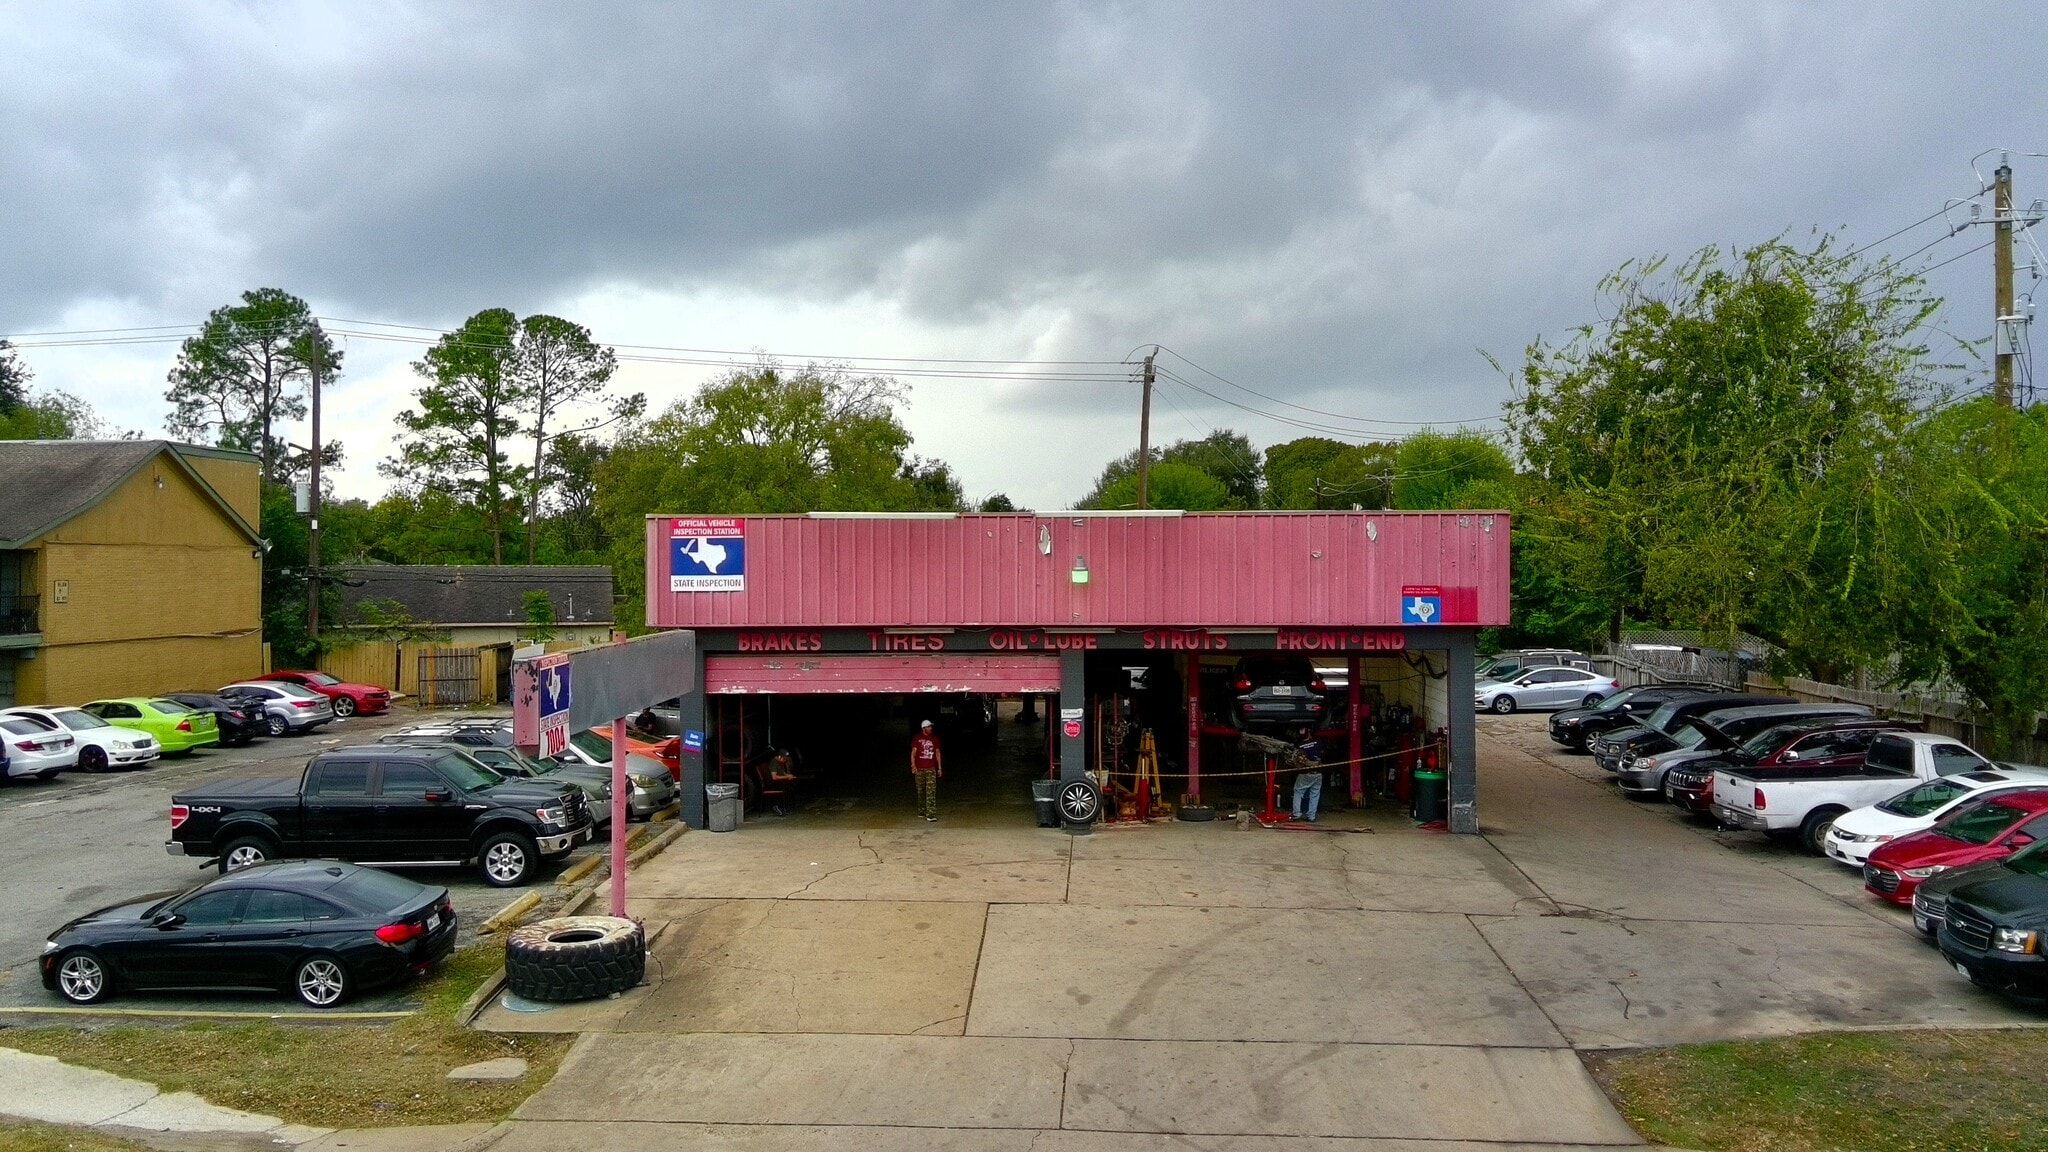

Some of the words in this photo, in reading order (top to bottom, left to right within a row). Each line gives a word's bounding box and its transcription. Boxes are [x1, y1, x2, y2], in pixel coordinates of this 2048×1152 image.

[673, 579, 695, 587] STATE
[696, 579, 741, 587] INSPECTION
[738, 633, 823, 651] BRAKES
[867, 632, 944, 650] TIRES
[989, 632, 1028, 649] OIL
[1043, 633, 1097, 649] LUBE
[1143, 632, 1228, 649] STRUTS
[1276, 632, 1349, 650] FRONT
[1363, 632, 1405, 650] END
